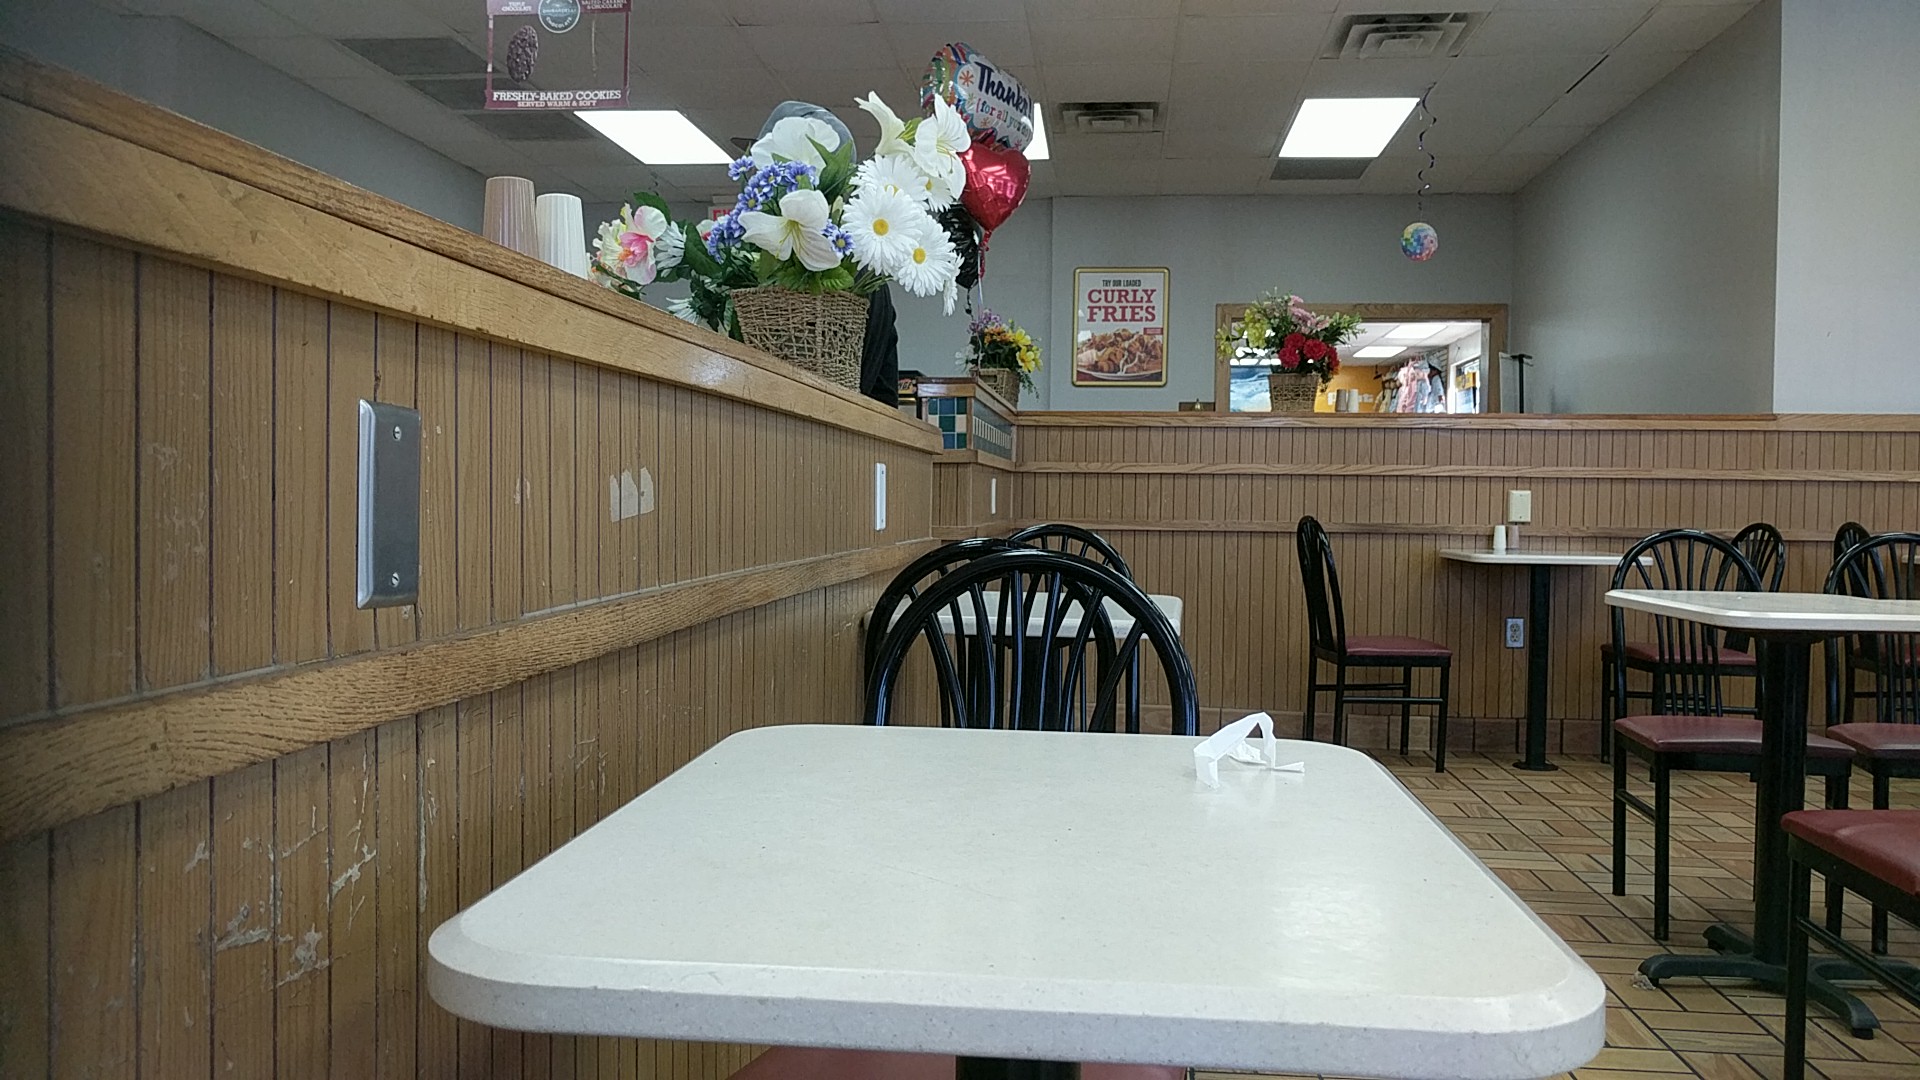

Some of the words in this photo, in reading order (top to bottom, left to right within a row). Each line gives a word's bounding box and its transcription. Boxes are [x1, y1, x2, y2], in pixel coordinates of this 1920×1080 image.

[492, 91, 573, 102] FRESHLY-BAKED
[575, 90, 622, 101] COOKIES
[973, 61, 1032, 118] Thanks!
[996, 109, 1009, 123] all
[1102, 279, 1111, 287] TRY
[1112, 279, 1122, 287] OUR
[1123, 279, 1142, 287] LOADED
[1087, 289, 1157, 304] CURLY
[1087, 305, 1156, 322] FRIES
